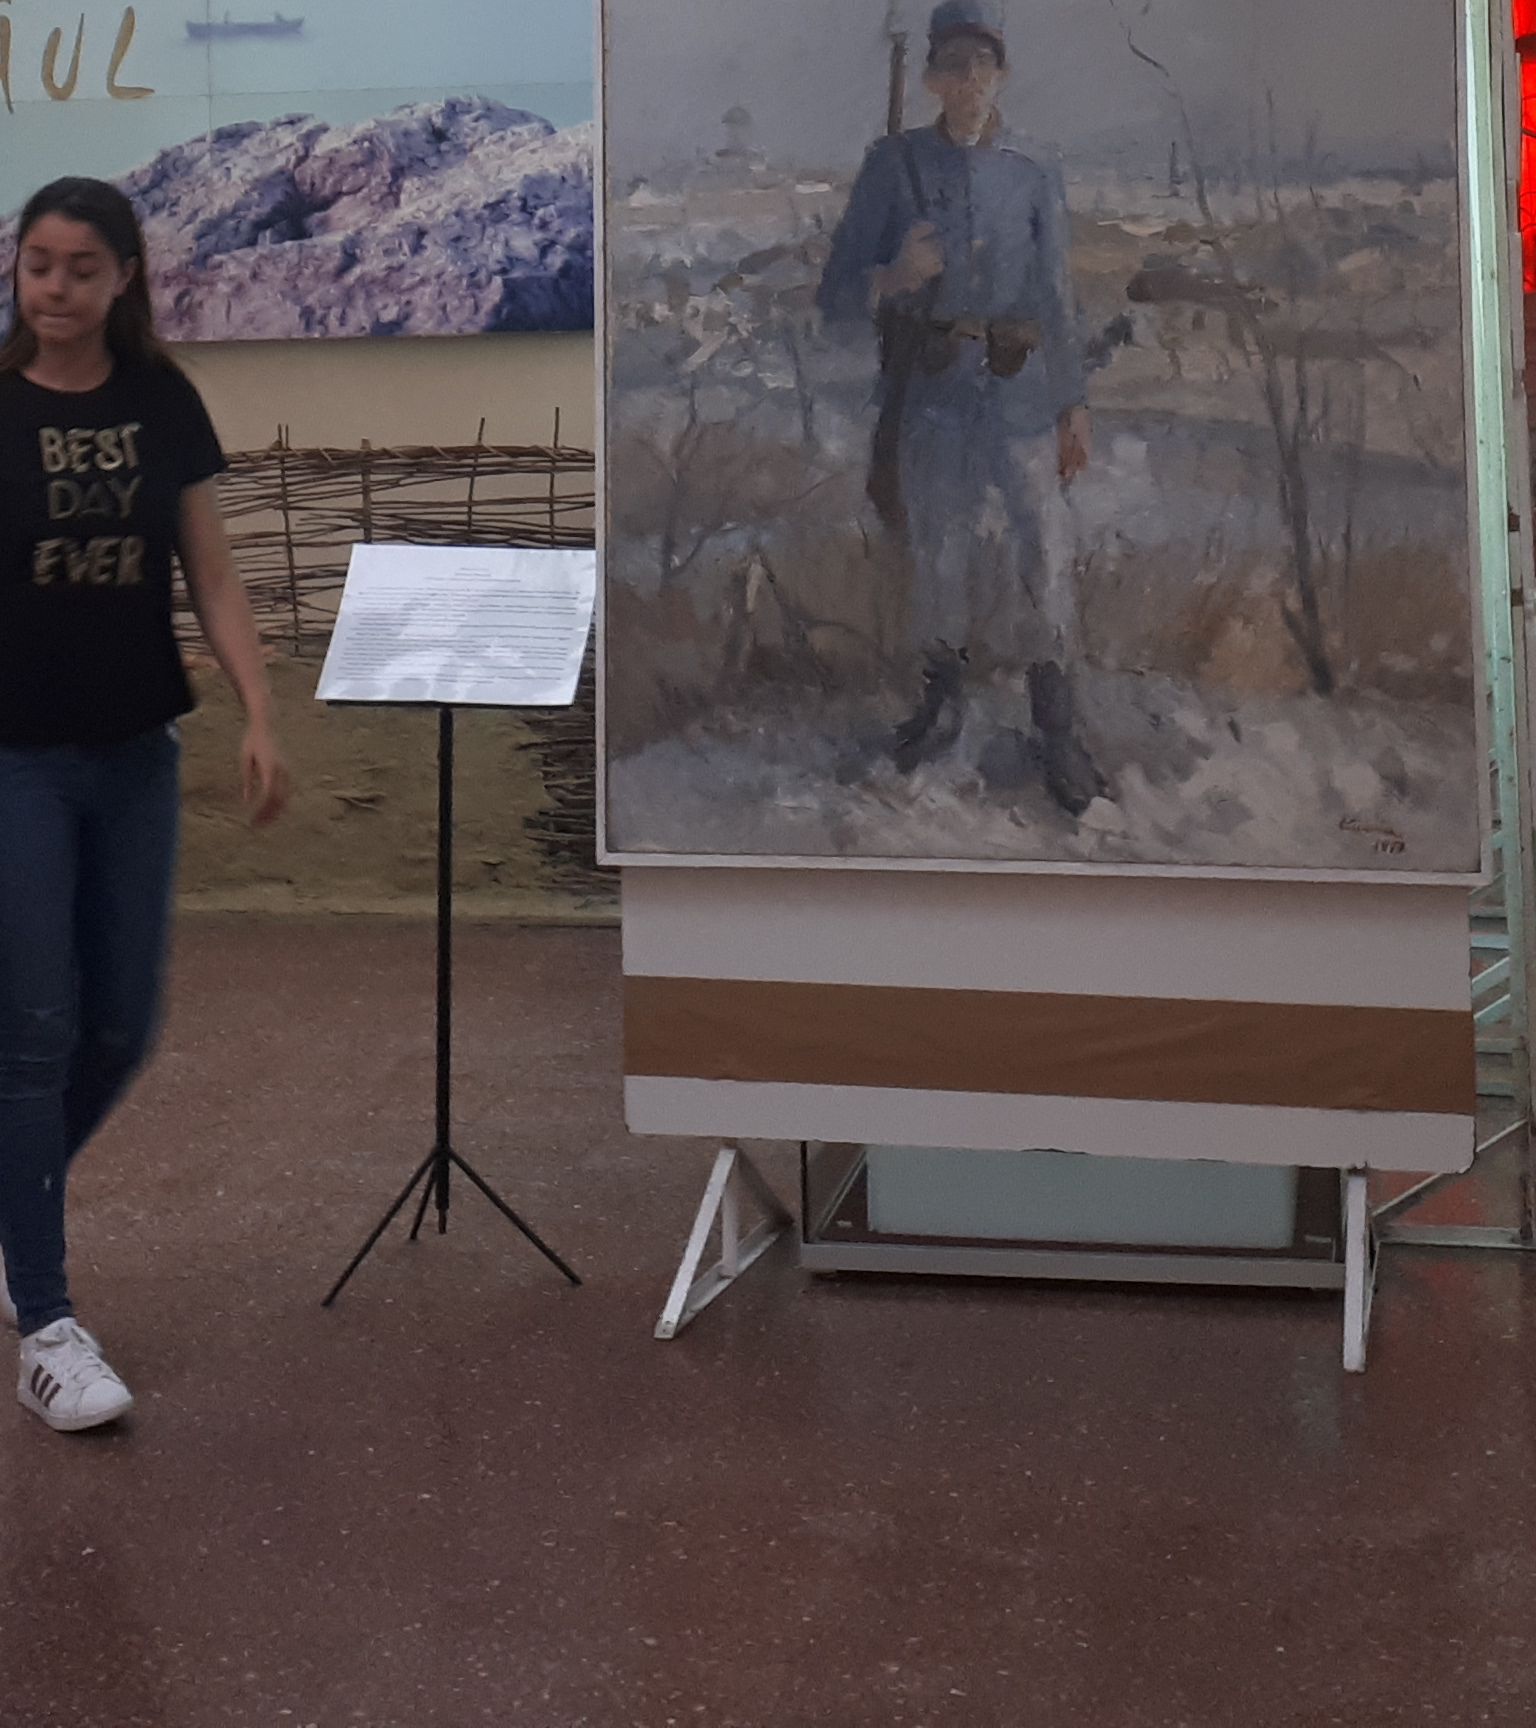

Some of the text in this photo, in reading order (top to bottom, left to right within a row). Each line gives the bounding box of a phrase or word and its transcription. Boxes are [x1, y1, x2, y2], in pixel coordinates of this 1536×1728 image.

[38, 422, 143, 473] BEST
[47, 475, 143, 521] DAY
[32, 534, 146, 586] EVER
